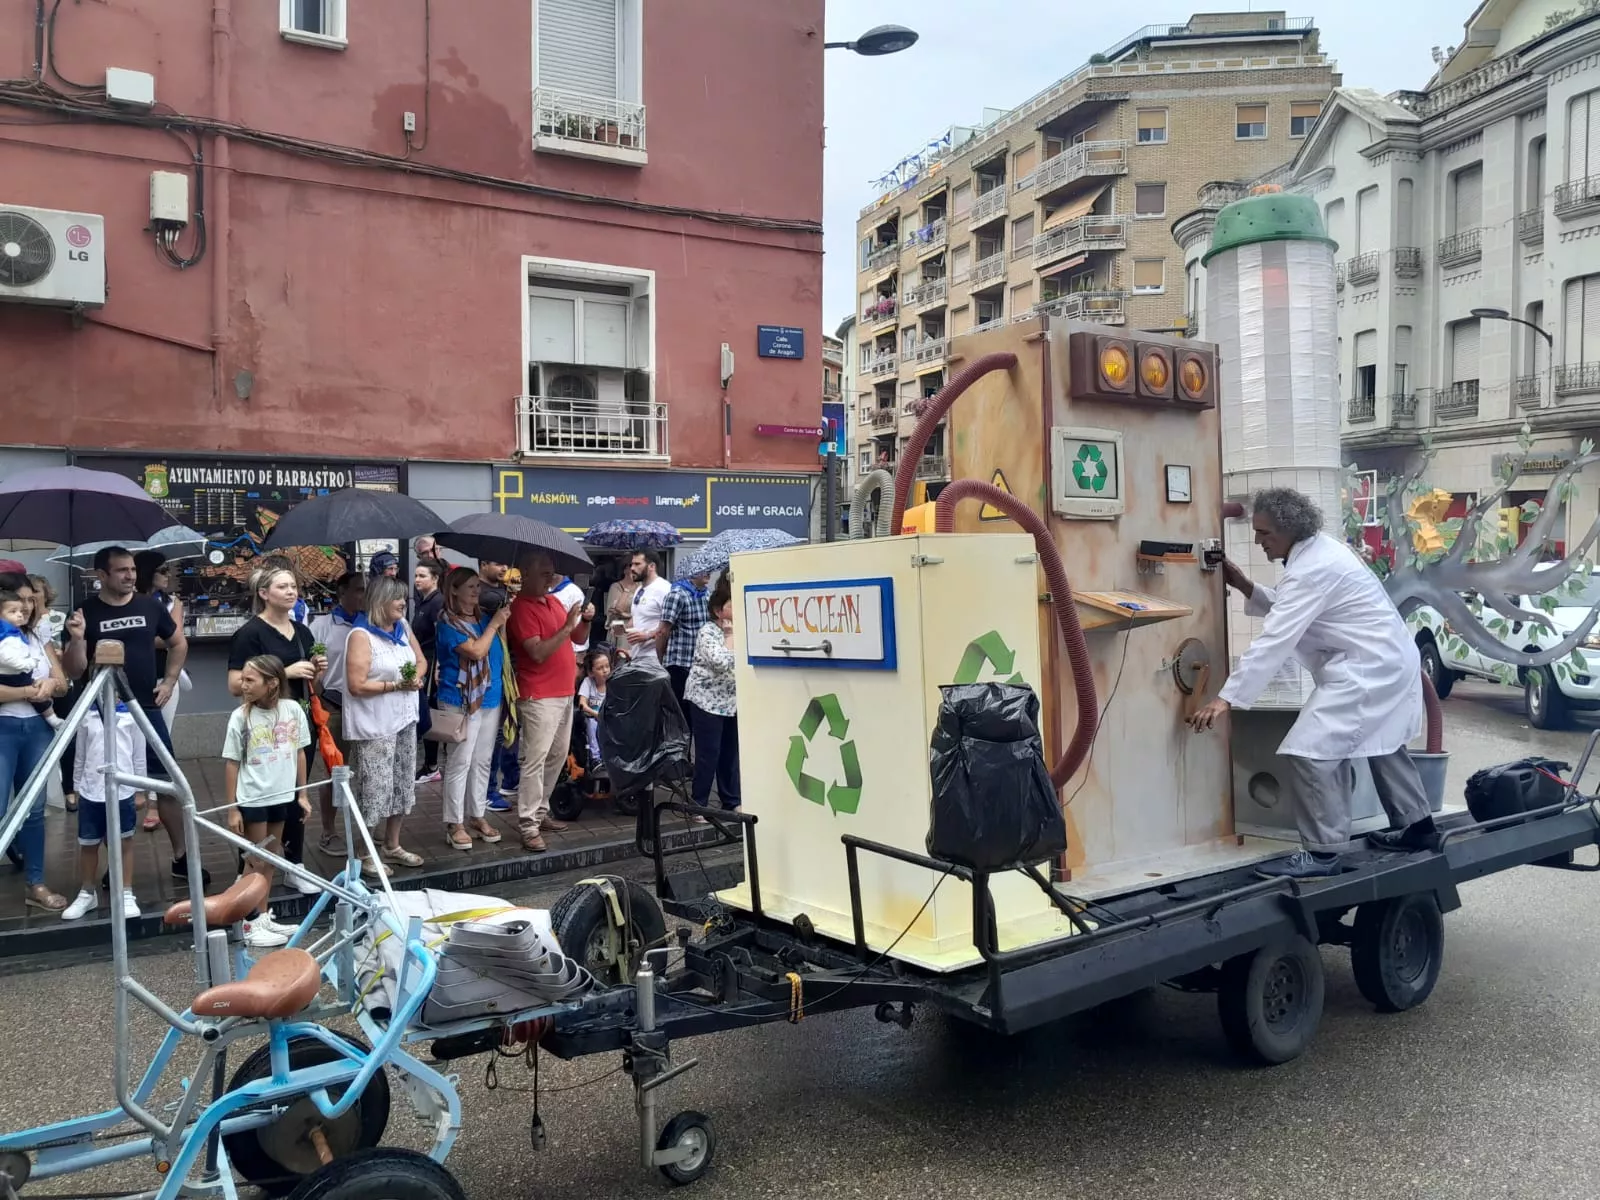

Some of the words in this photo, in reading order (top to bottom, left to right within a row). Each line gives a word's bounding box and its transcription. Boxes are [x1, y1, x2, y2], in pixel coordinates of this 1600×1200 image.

[68, 250, 89, 262] LG
[169, 467, 256, 484] AYUNTAMIENTO
[259, 470, 273, 486] DE
[276, 470, 345, 488] BARBASTRO
[587, 495, 649, 507] pepephone
[715, 504, 745, 516] JOSÉ
[747, 505, 760, 516] Mª
[763, 505, 804, 516] GRACIA
